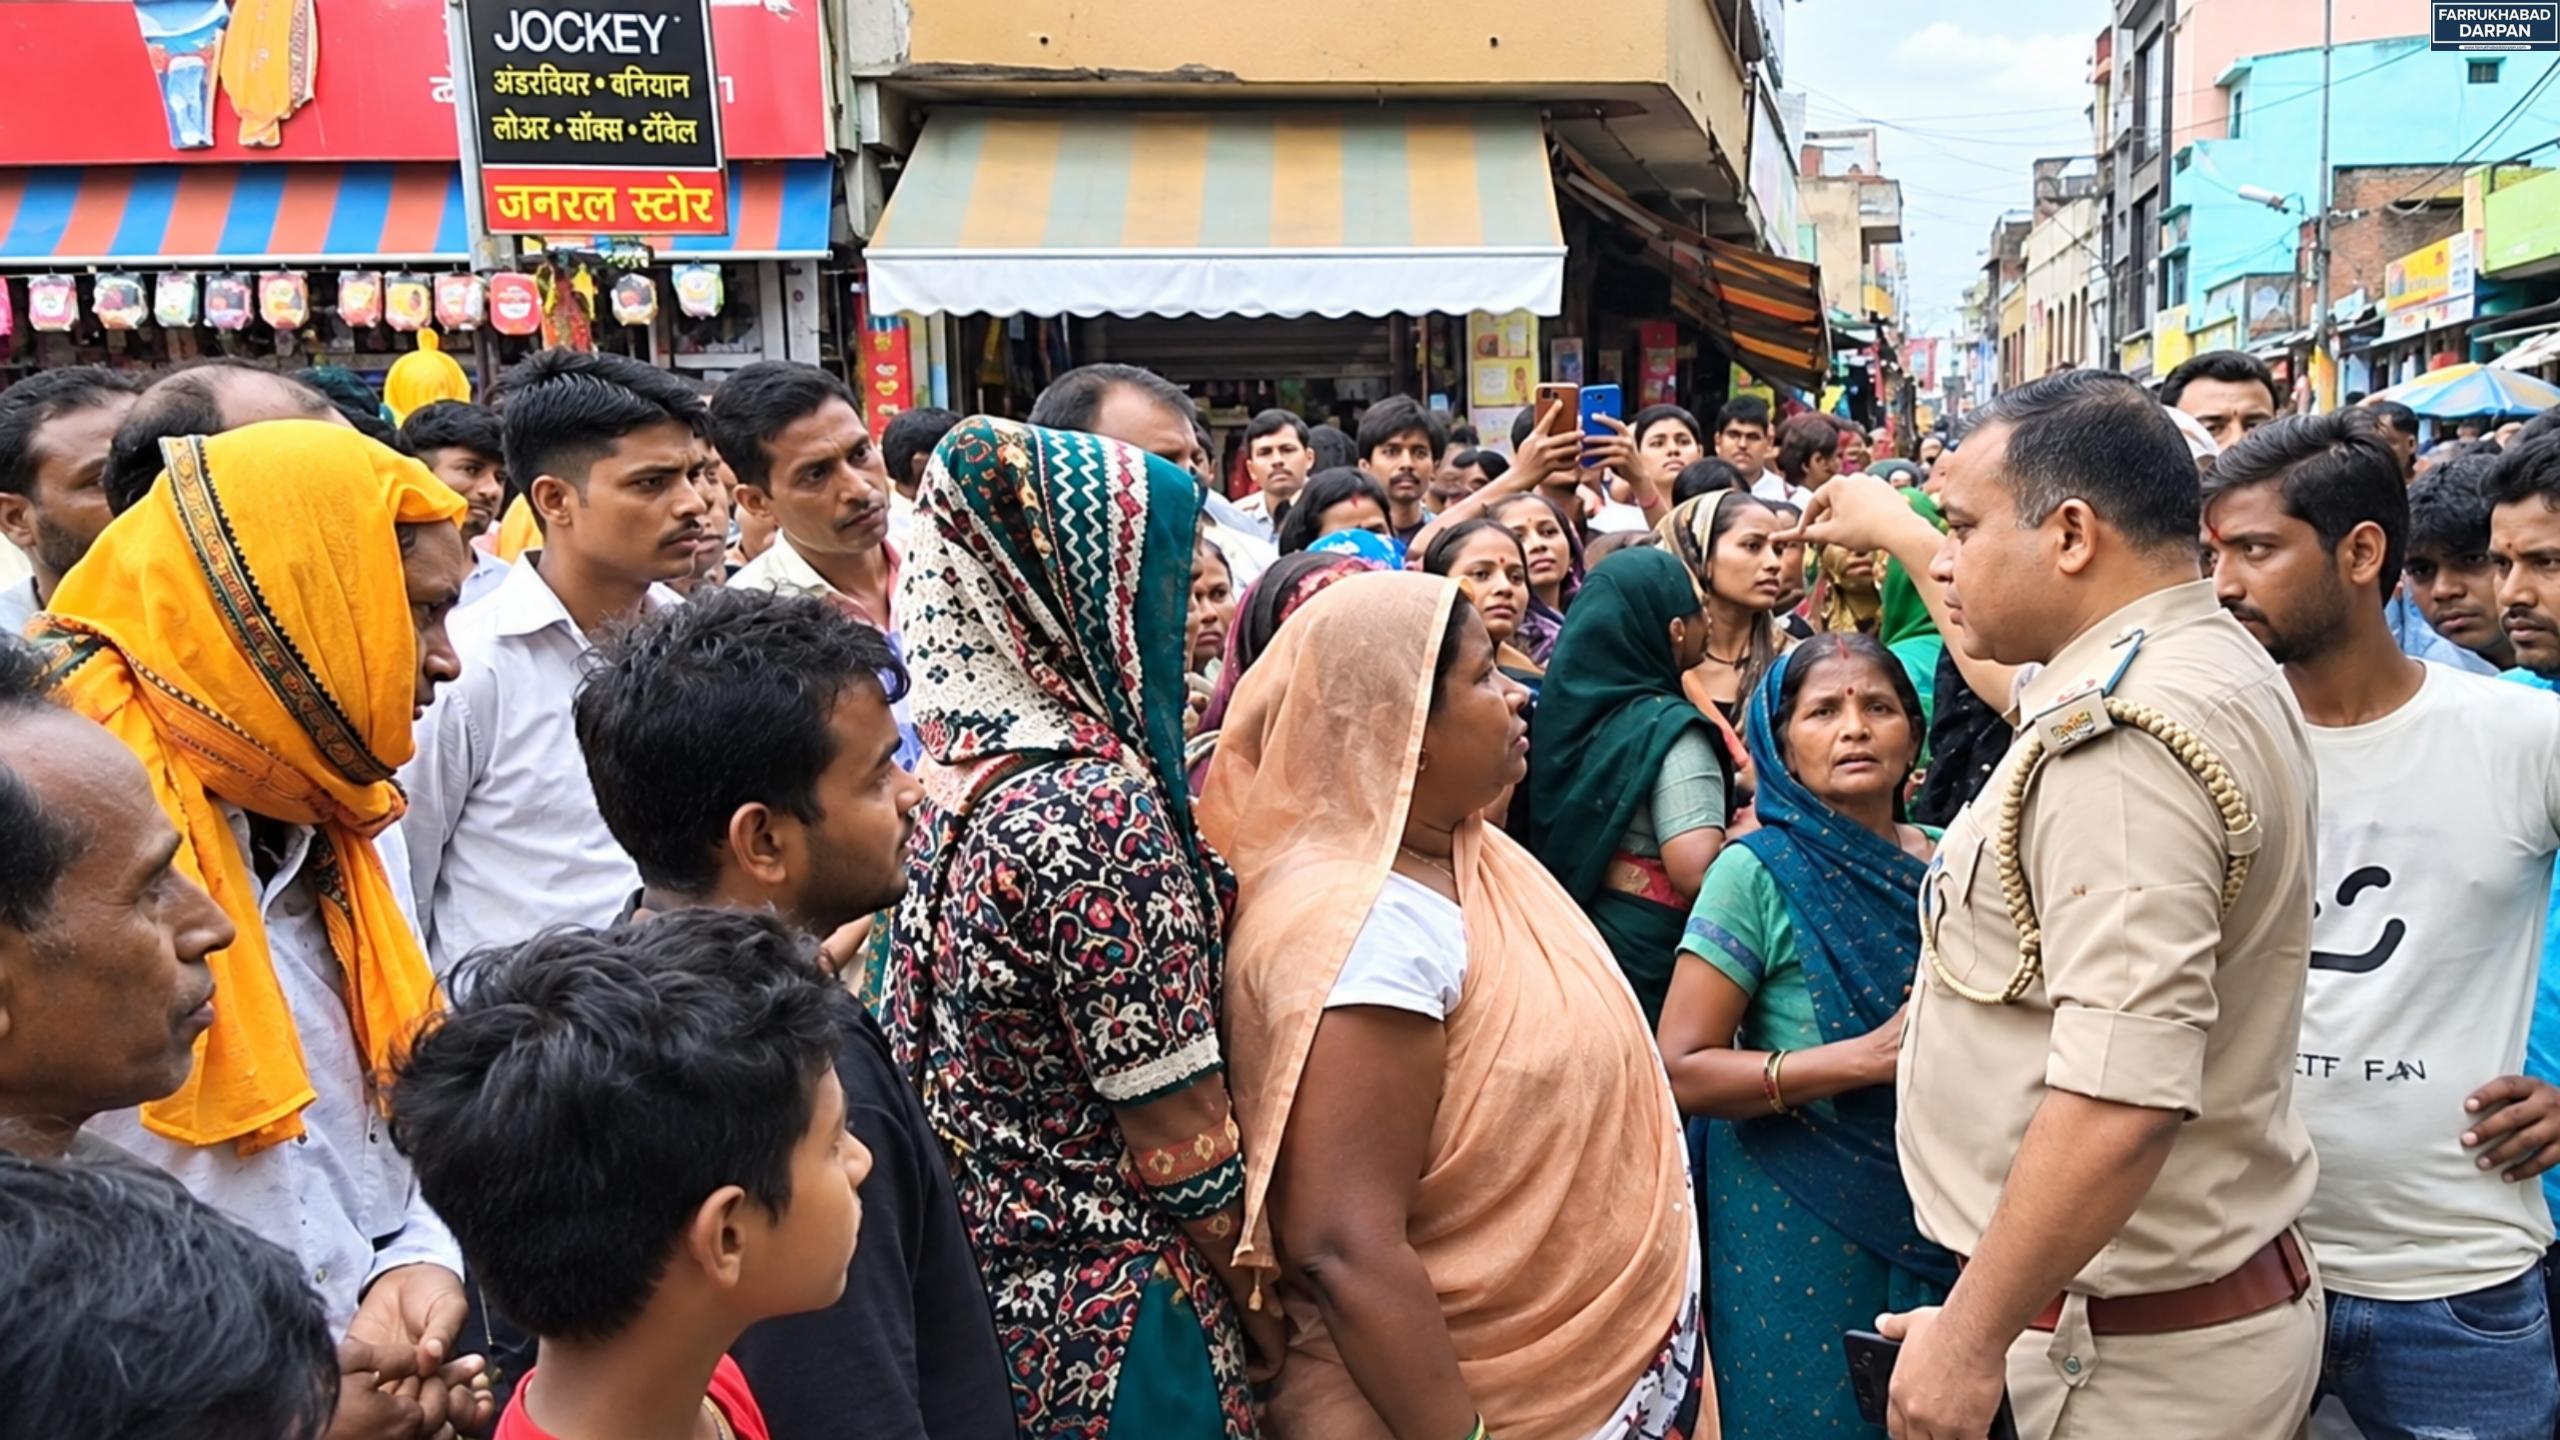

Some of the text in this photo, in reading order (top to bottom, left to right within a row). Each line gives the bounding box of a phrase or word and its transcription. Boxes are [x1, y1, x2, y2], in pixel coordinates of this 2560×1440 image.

[493, 10, 667, 54] JOCKEY
[493, 62, 591, 97] अंडरवियर
[491, 107, 698, 144] लोअर सॉक्स टॉवेल
[494, 175, 714, 223] जनरल स्टोर
[2364, 1059, 2426, 1081] FAN
